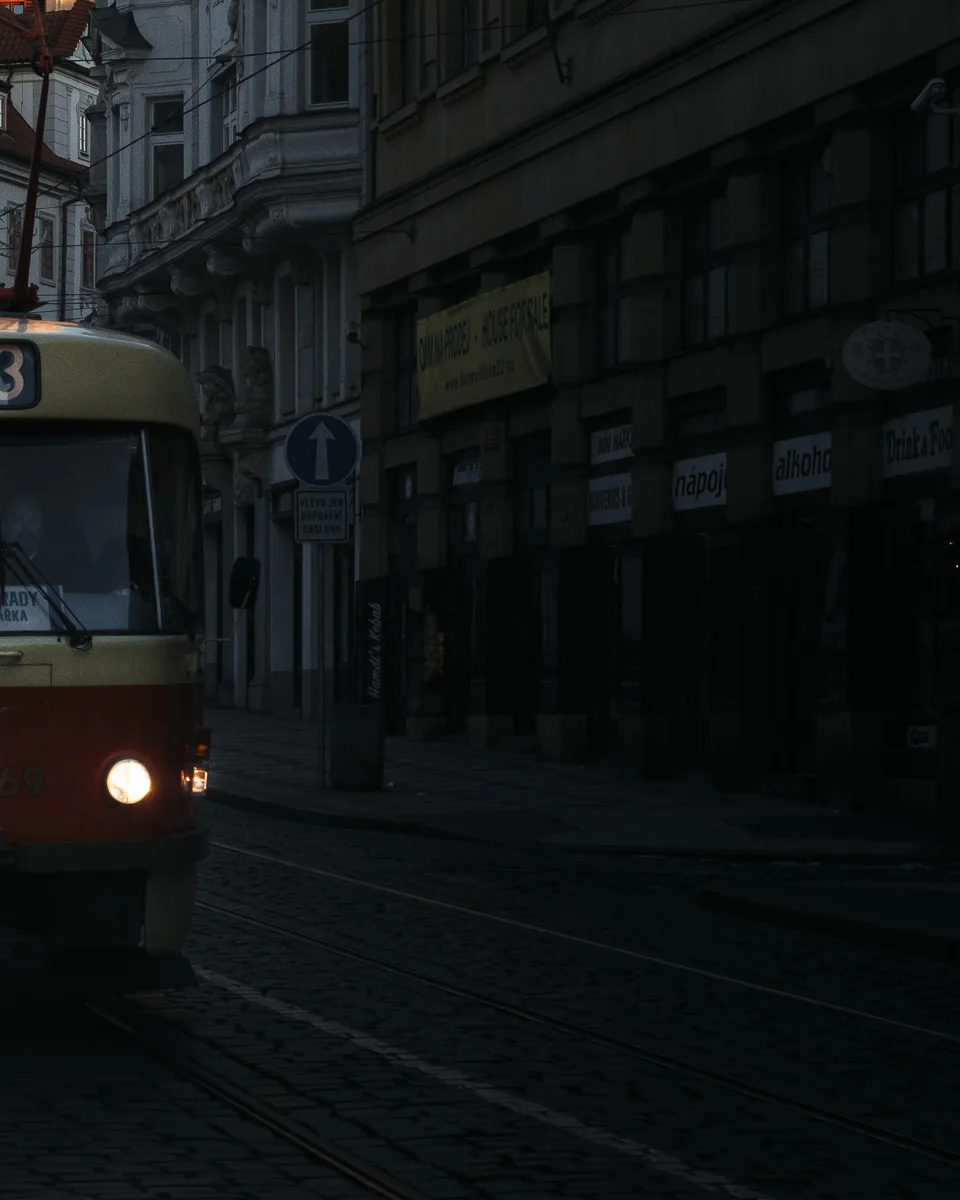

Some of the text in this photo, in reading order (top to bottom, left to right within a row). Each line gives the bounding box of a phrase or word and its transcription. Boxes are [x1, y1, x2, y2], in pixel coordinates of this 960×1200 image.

[886, 426, 920, 463] Drink
[674, 462, 728, 501] nápoj
[300, 496, 326, 508] VLEVO
[368, 602, 382, 642] Kebab
